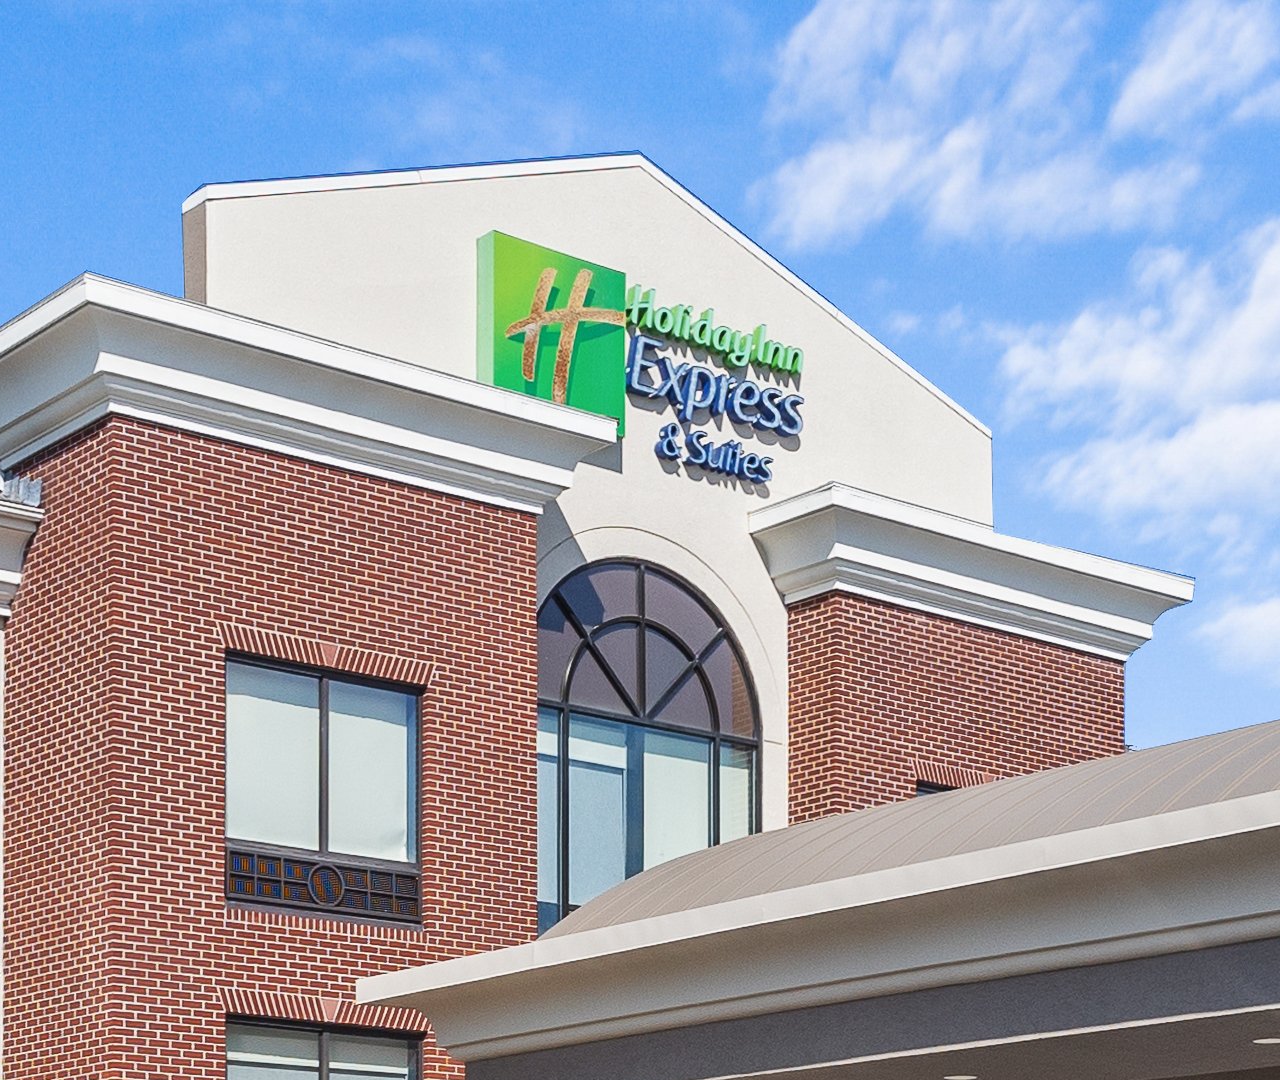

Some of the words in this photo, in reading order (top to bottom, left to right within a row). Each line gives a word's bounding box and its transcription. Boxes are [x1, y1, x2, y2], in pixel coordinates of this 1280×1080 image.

[625, 284, 753, 368] Holiday
[751, 323, 804, 375] Inn
[625, 334, 805, 436] Express
[654, 422, 683, 460] &
[684, 430, 774, 485] Suites
